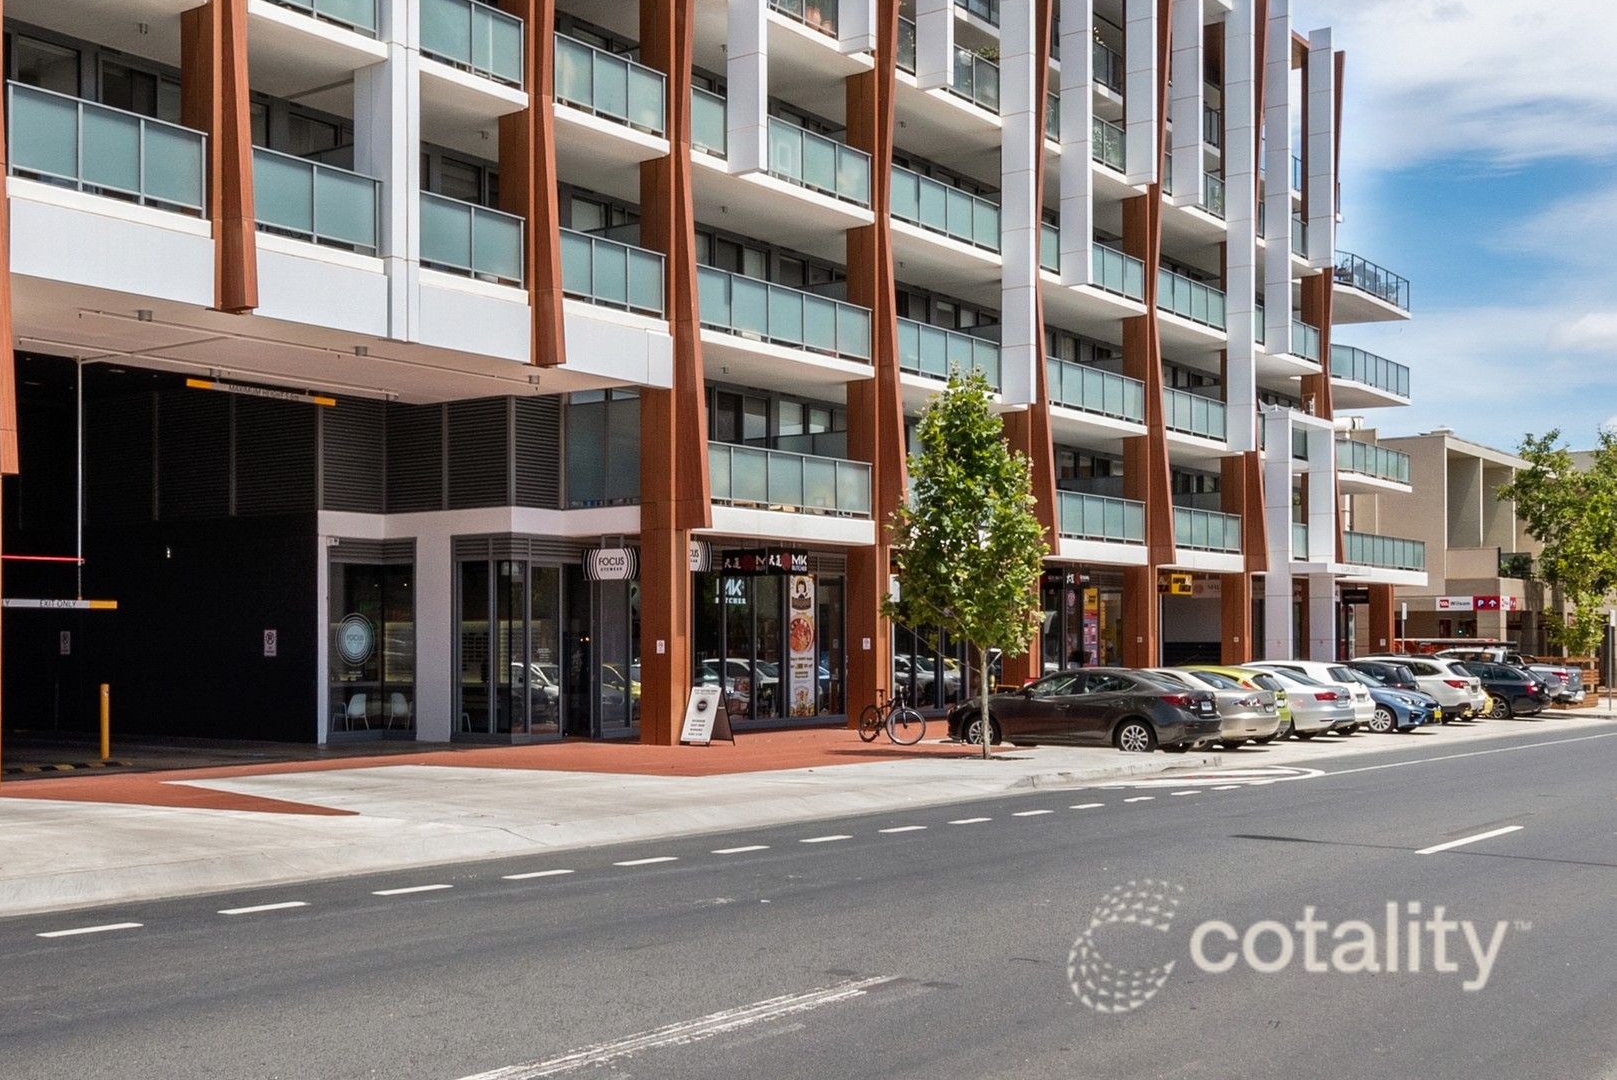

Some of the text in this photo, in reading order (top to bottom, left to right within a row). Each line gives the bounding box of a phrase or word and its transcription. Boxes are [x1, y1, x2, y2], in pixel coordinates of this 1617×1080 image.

[598, 557, 625, 566] FOCUS
[791, 554, 807, 565] MK
[40, 600, 77, 608] EXIT ONLY
